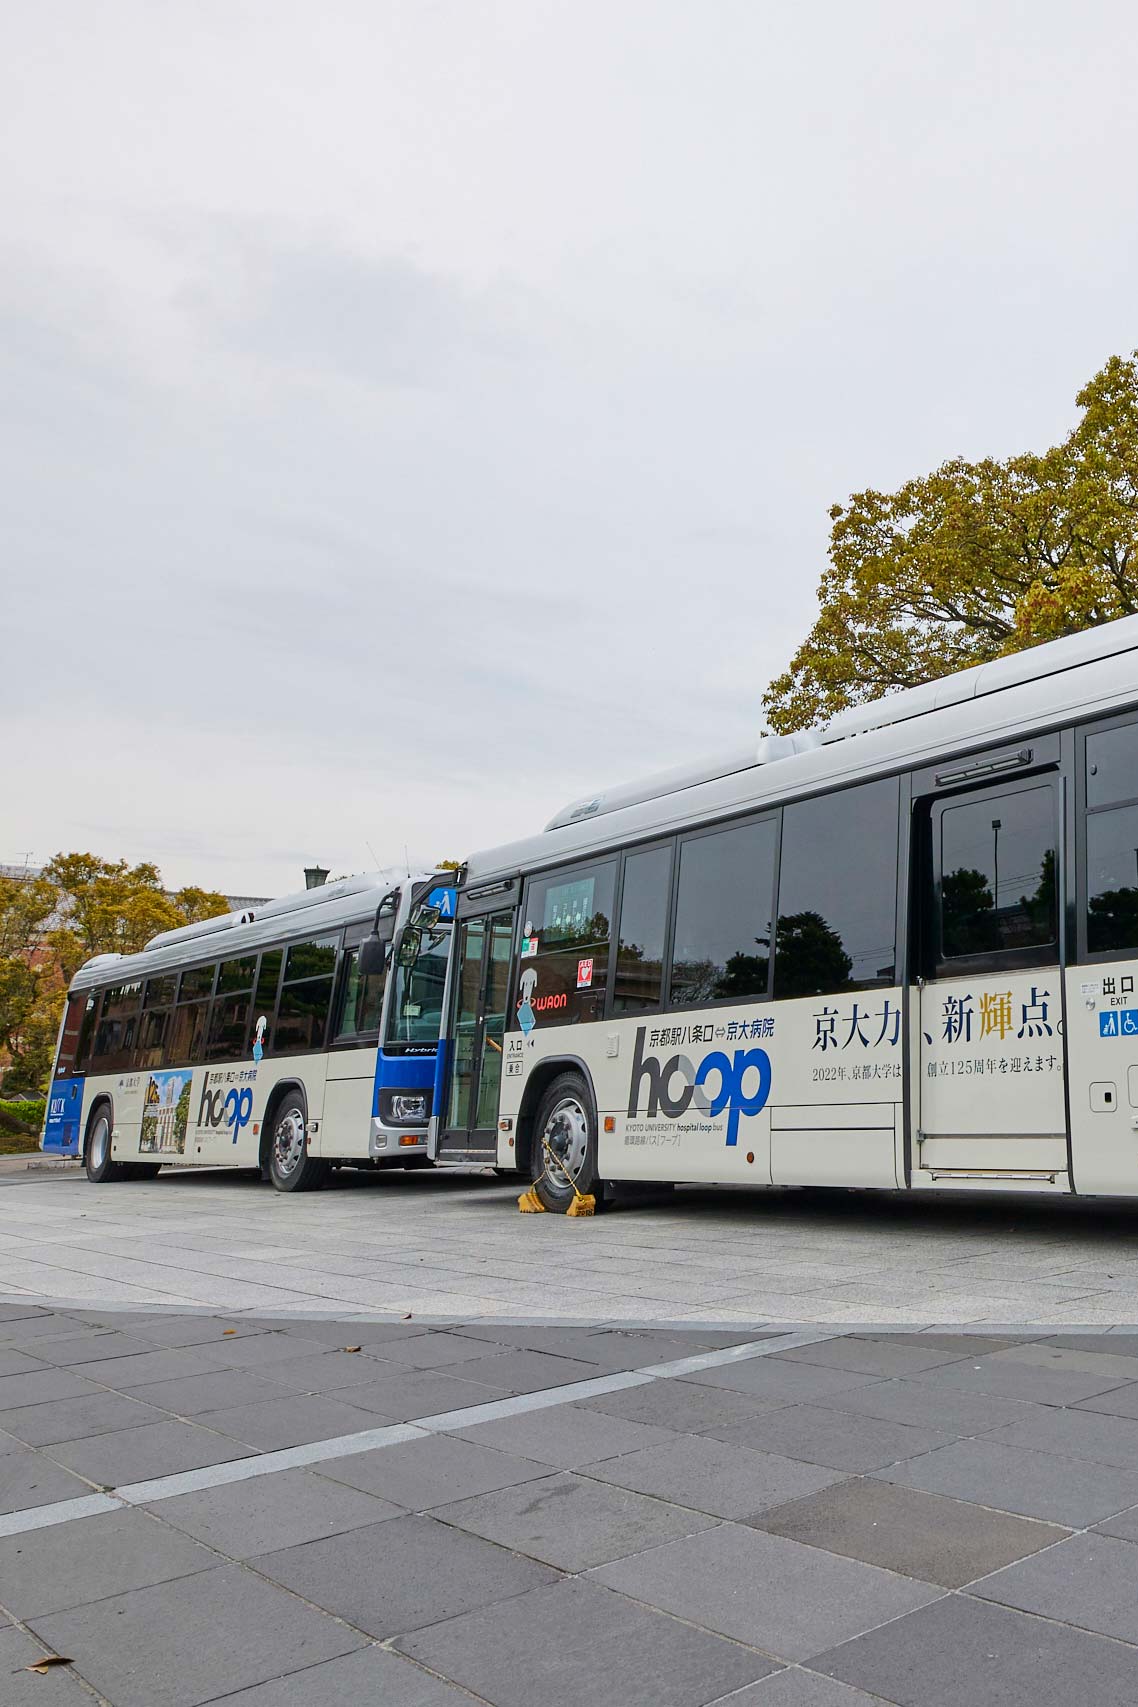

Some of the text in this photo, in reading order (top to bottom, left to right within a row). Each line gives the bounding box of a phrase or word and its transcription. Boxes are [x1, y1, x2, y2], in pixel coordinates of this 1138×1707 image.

[1103, 975, 1134, 995] 出口
[536, 993, 567, 1010] WAON
[1110, 996, 1128, 1006] EXIT
[649, 1017, 775, 1048] 京都駅八条口 京大病院
[509, 1040, 523, 1051] 入口
[812, 1055, 1063, 1082] 2022年、京都大学は 創立125周年を迎えます。
[627, 1026, 772, 1147] hoop
[625, 1122, 724, 1133] KYOTO UNIVERSITY hospital loop bus
